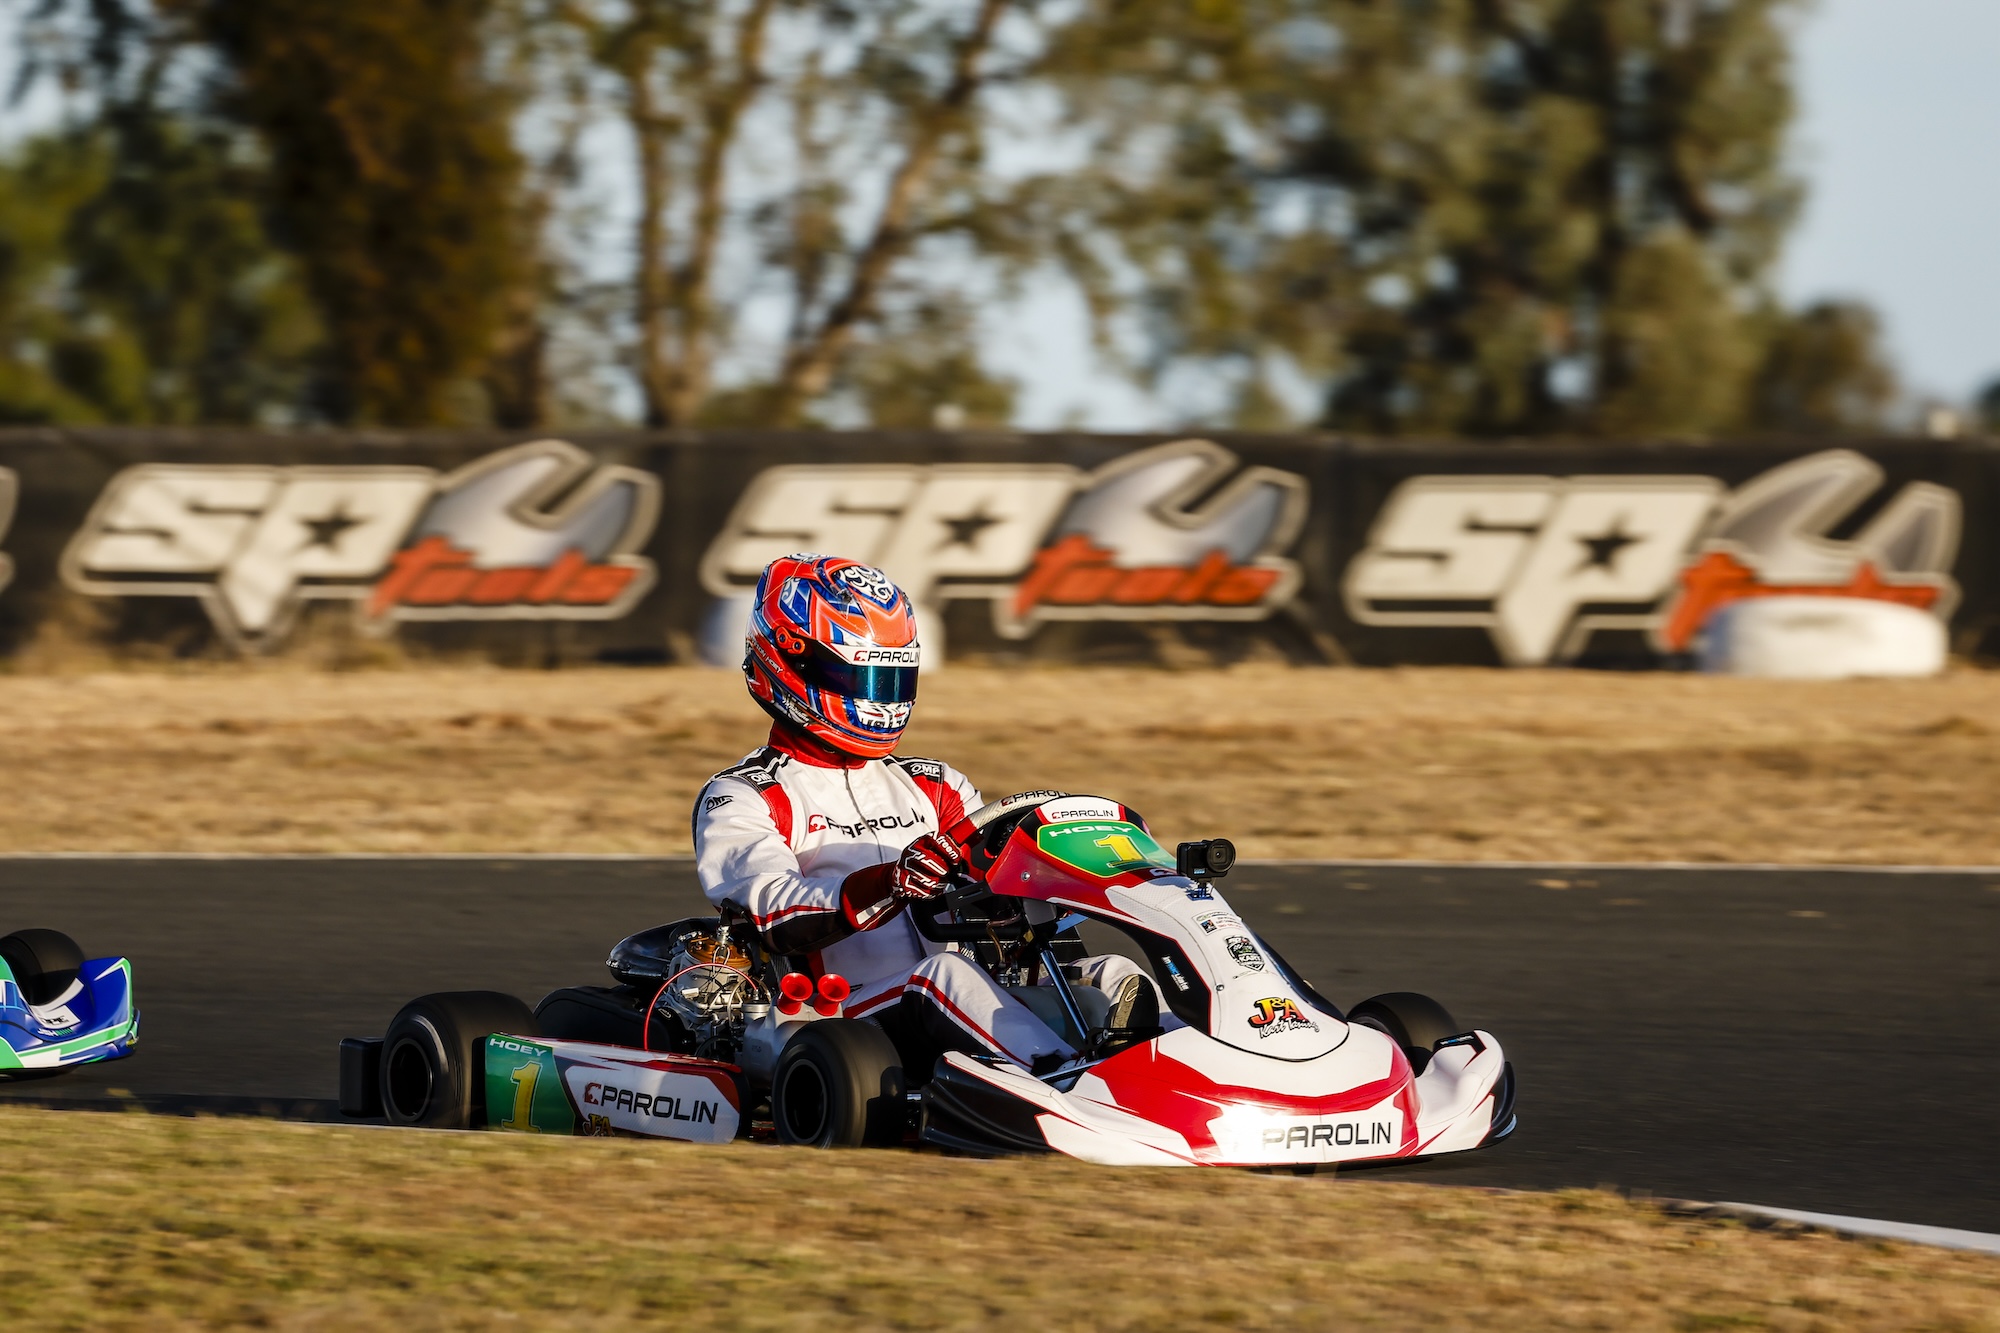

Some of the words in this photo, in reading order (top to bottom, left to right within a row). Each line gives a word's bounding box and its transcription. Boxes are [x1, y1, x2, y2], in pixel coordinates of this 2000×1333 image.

[76, 474, 440, 632] SP
[1352, 486, 1723, 662] SP
[911, 764, 940, 775] OMP
[1060, 809, 1114, 819] PAROLIN
[1048, 825, 1132, 838] HOEY
[1093, 834, 1149, 868] 1
[1247, 997, 1310, 1029] J&A
[490, 1038, 547, 1057] HOEY
[501, 1060, 543, 1133] 1
[601, 1085, 719, 1124] PAROLIN
[1262, 1121, 1391, 1150] PAROLIN
